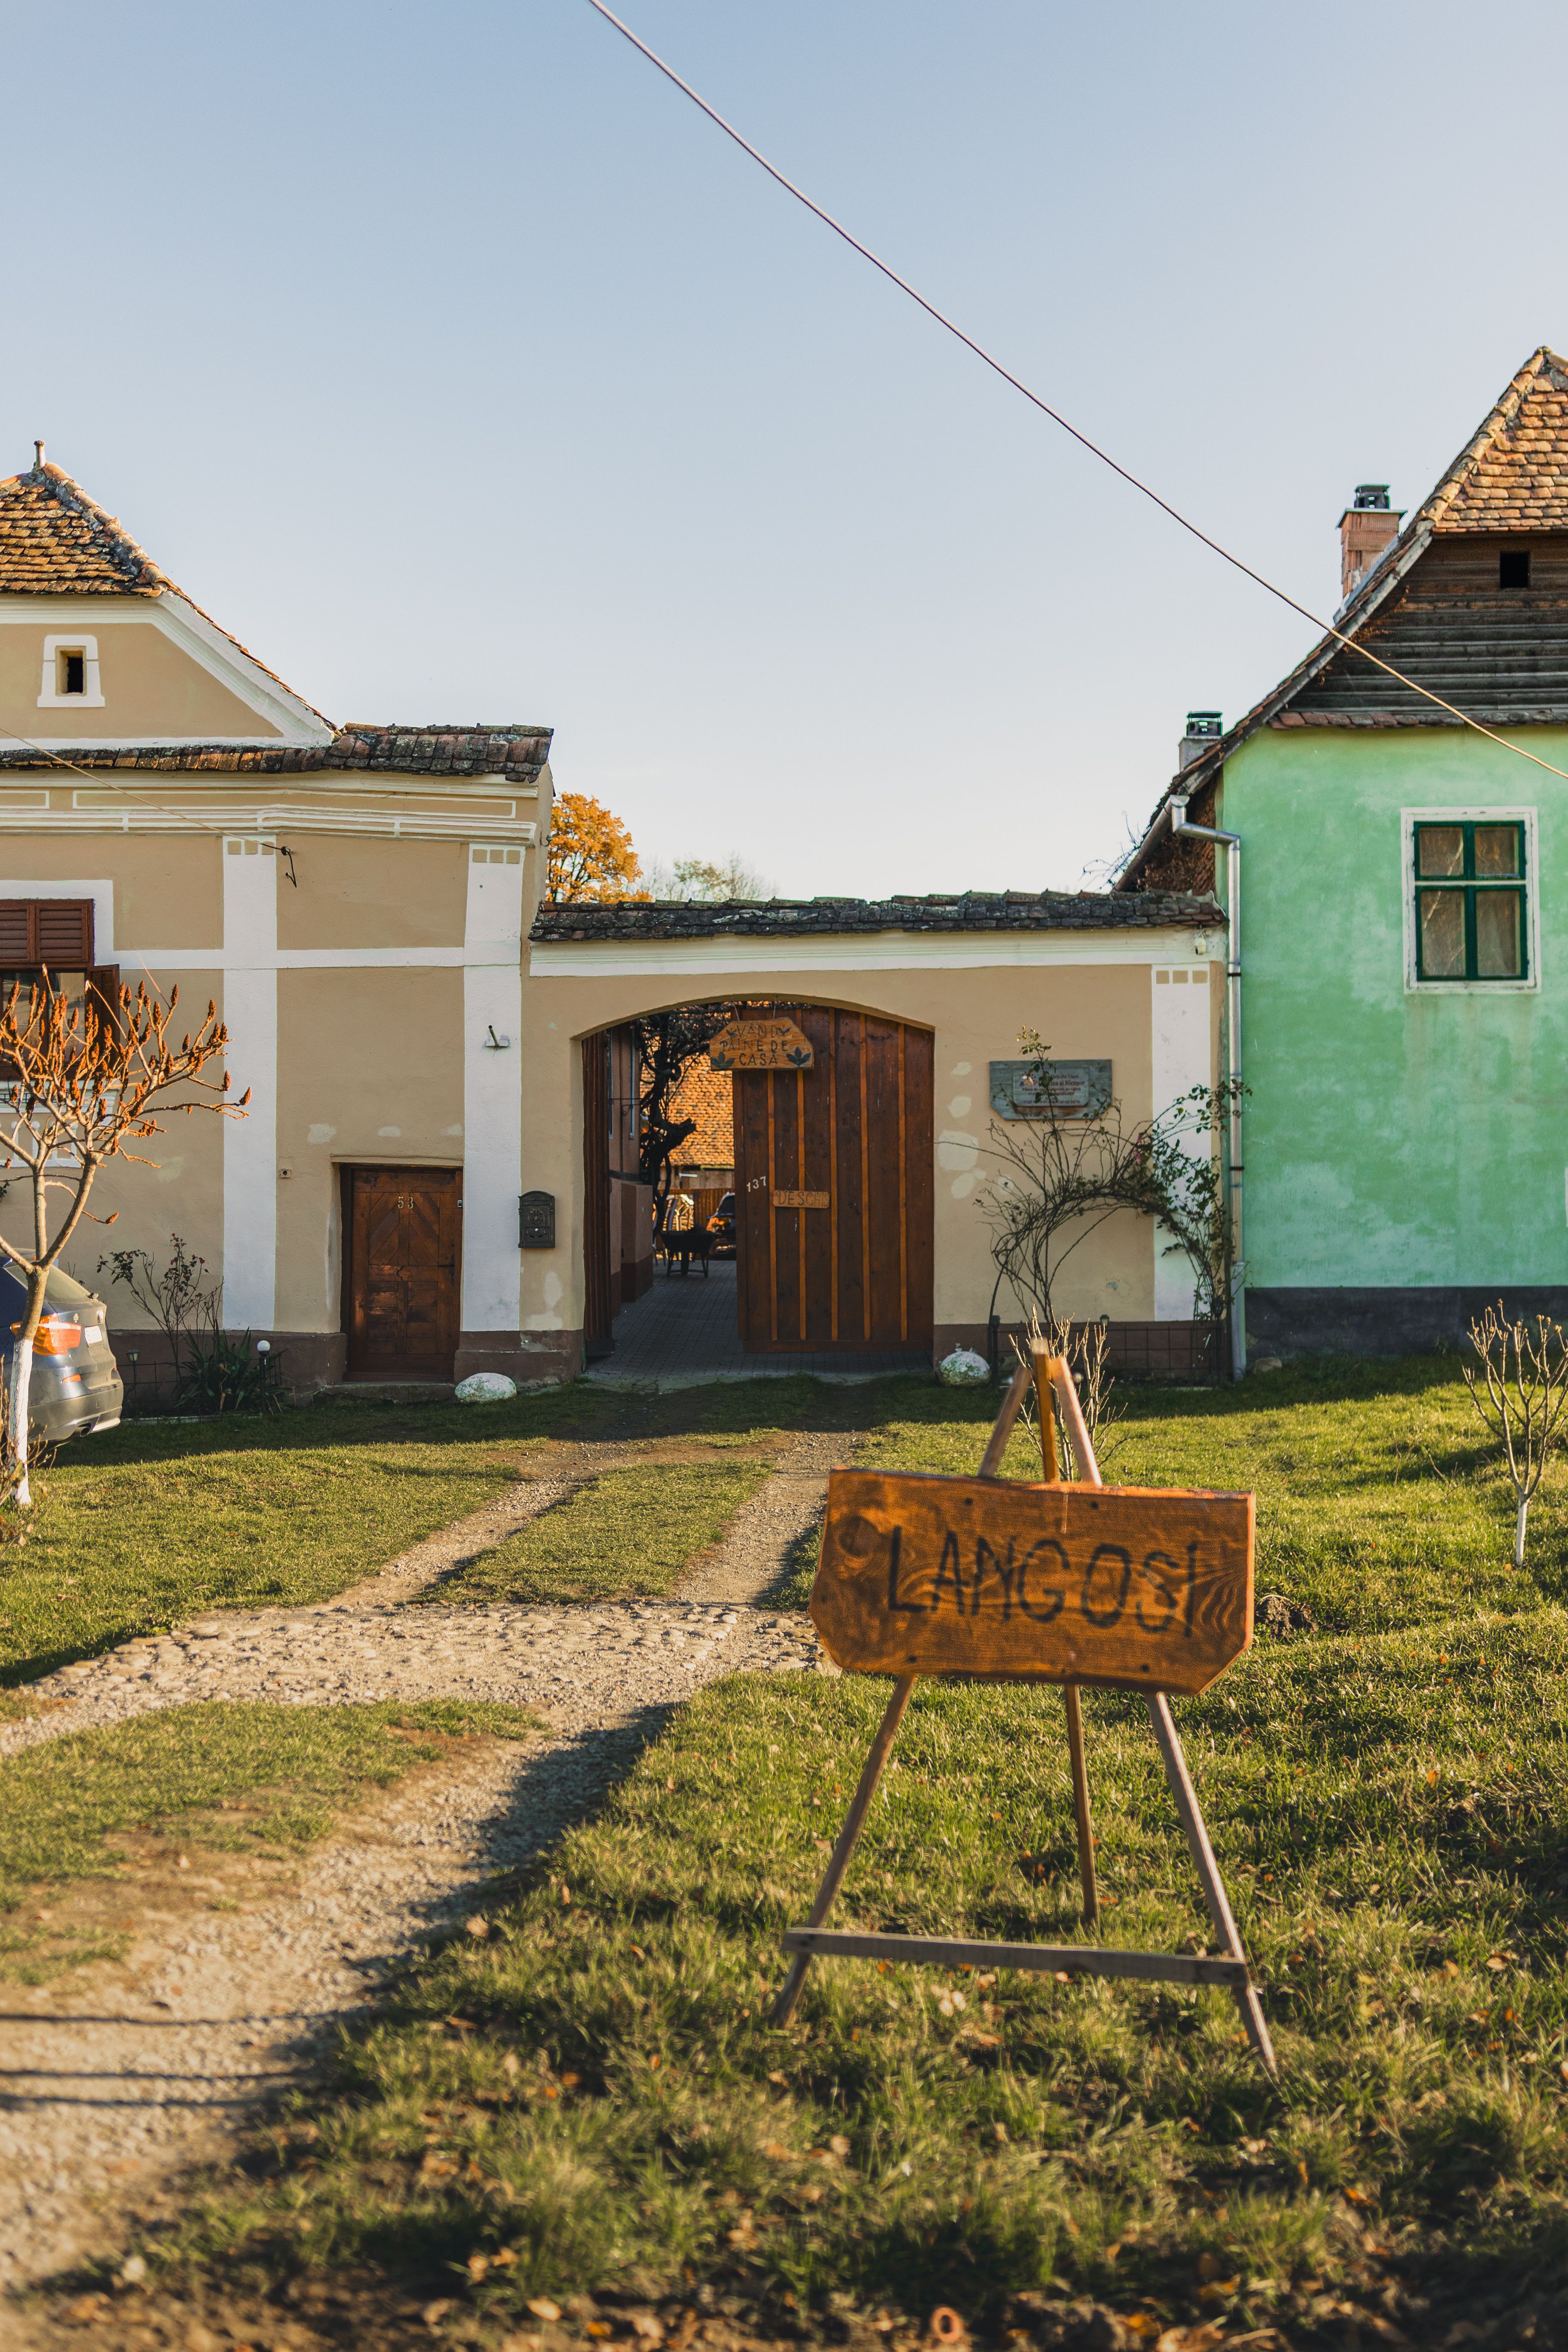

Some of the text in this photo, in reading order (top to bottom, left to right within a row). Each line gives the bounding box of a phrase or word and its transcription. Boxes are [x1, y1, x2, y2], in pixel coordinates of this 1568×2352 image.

[771, 1040, 788, 1051] DE
[746, 1176, 766, 1192] 137
[398, 1196, 413, 1209] 53
